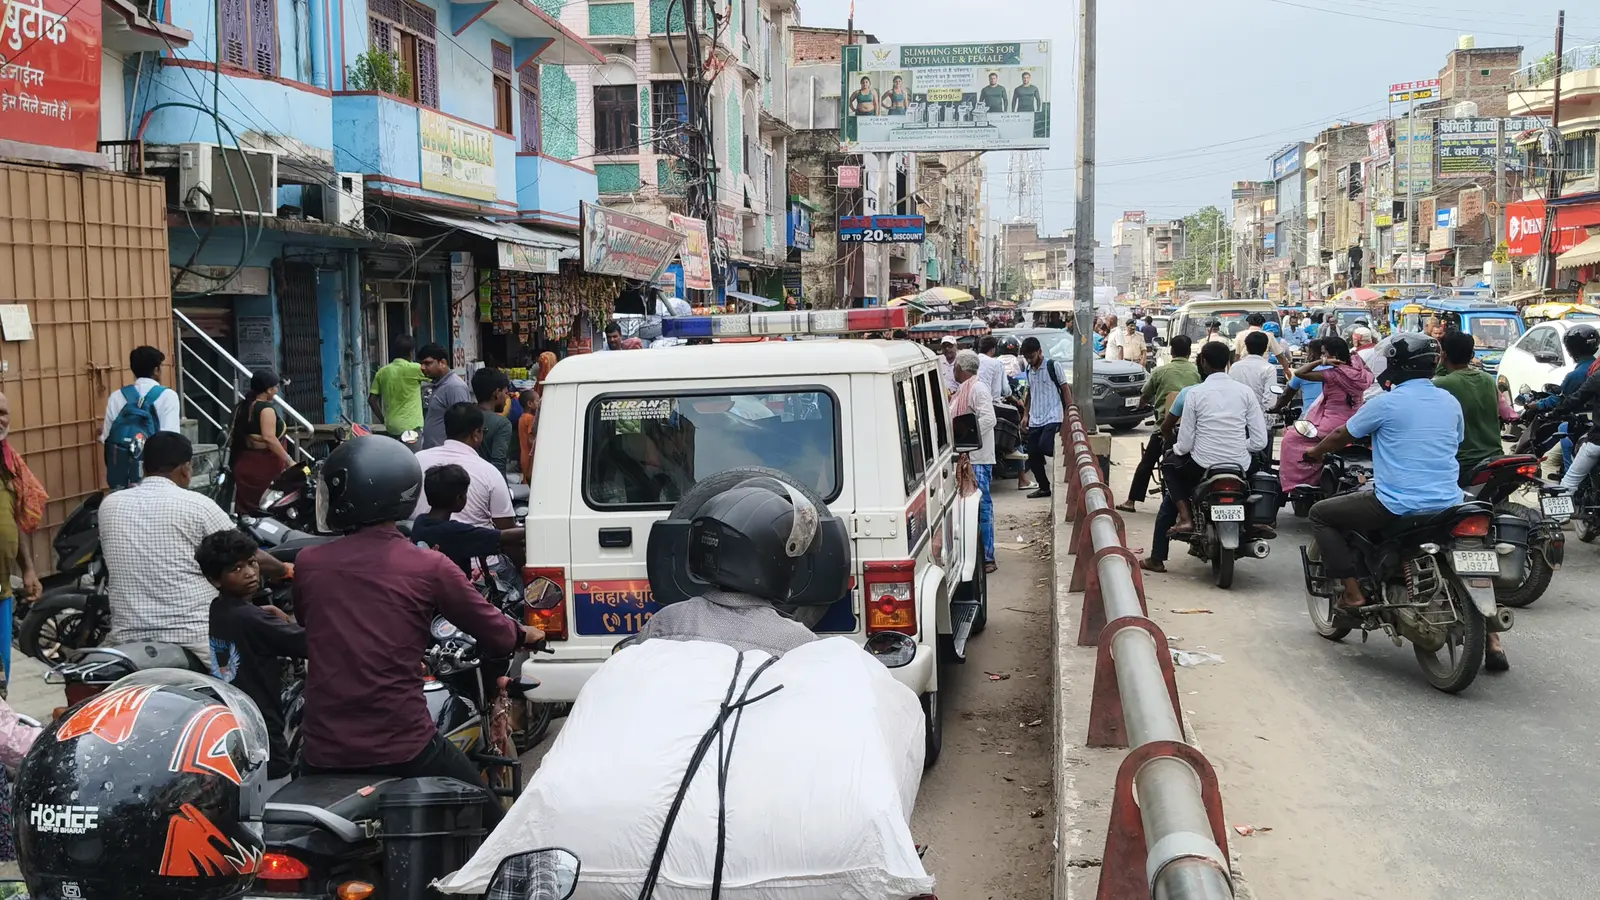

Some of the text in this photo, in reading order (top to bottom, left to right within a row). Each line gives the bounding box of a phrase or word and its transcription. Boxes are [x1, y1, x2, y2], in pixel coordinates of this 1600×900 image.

[904, 45, 1015, 57] SLIMMING SERVICES FOR
[931, 56, 957, 64] MALE
[968, 54, 1003, 63] FEMALE
[1389, 82, 1413, 92] JEET
[589, 585, 629, 606] बिहार
